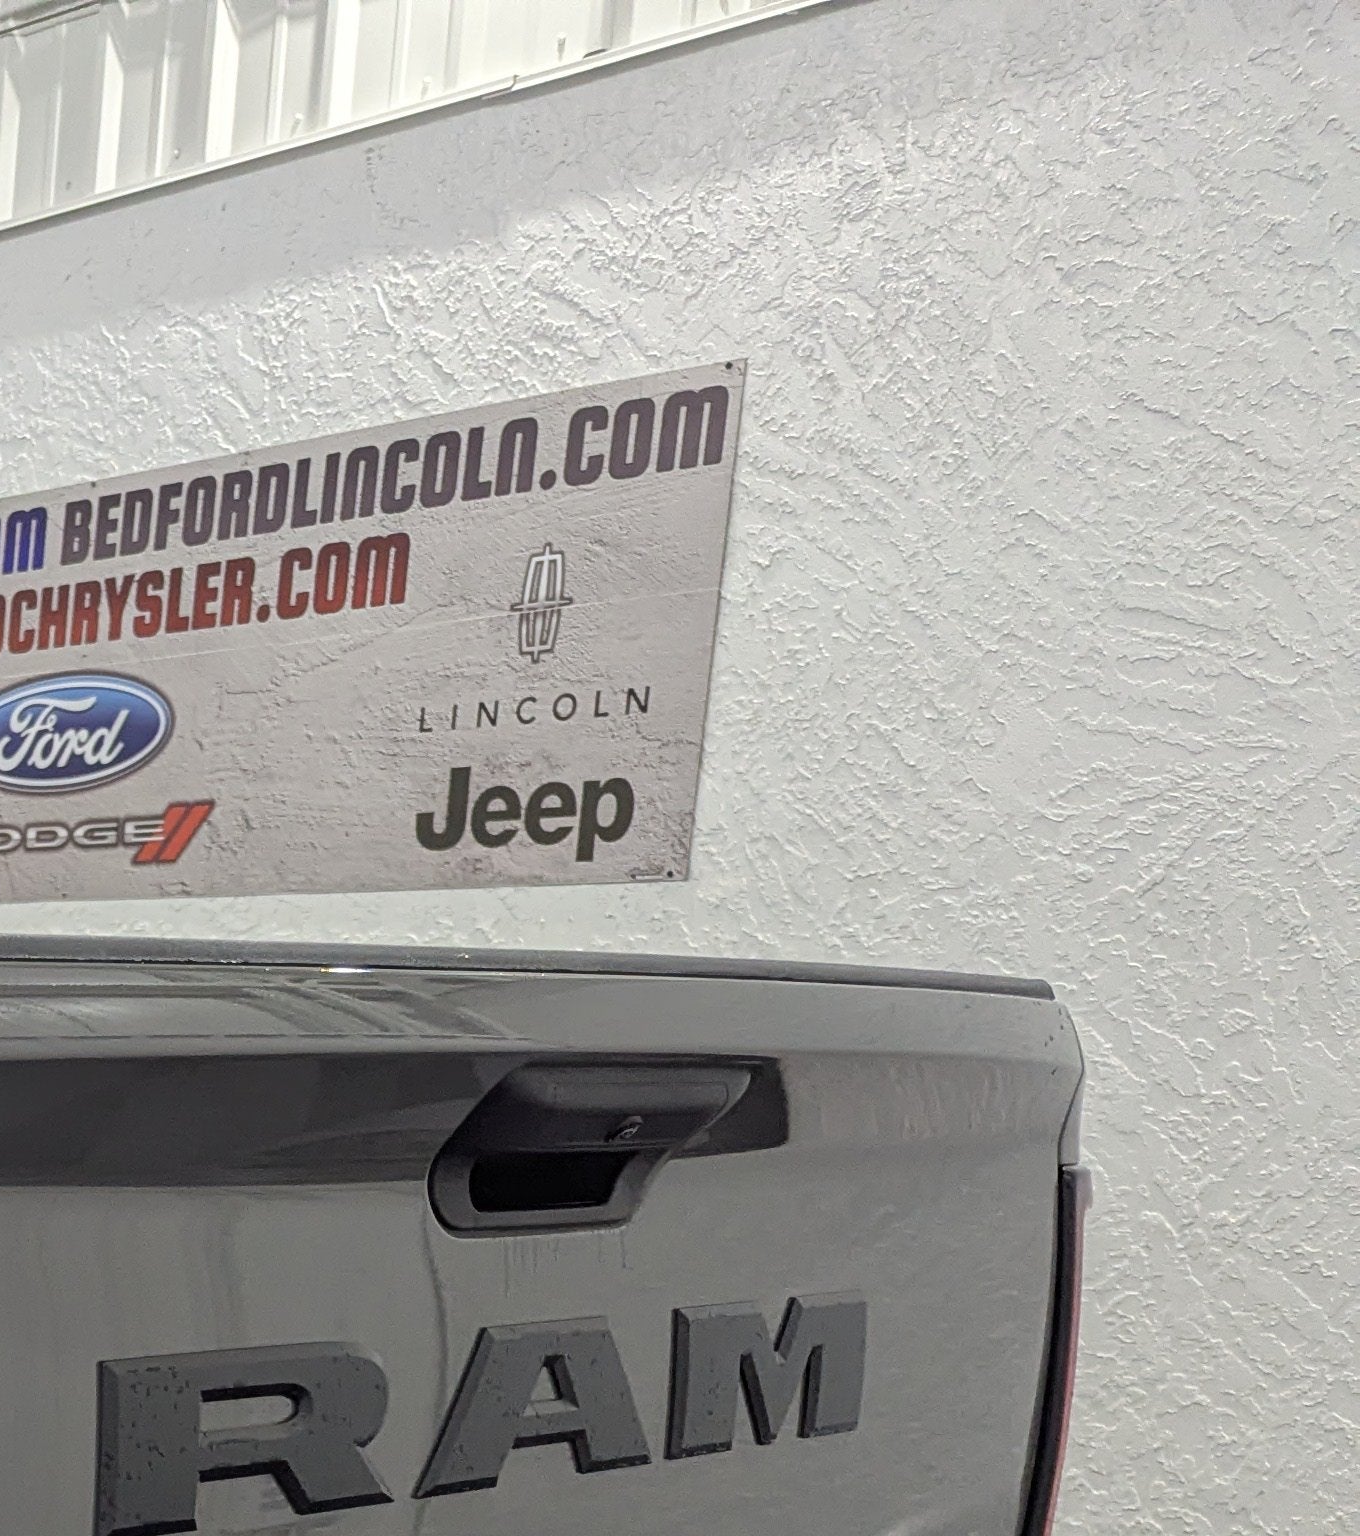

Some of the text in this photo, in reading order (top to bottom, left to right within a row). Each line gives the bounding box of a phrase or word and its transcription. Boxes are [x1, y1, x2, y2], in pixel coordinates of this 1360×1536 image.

[60, 384, 729, 566] BEDFORDLINCOLN.COM
[419, 686, 651, 733] LINCOLN
[415, 766, 635, 862] Jeep
